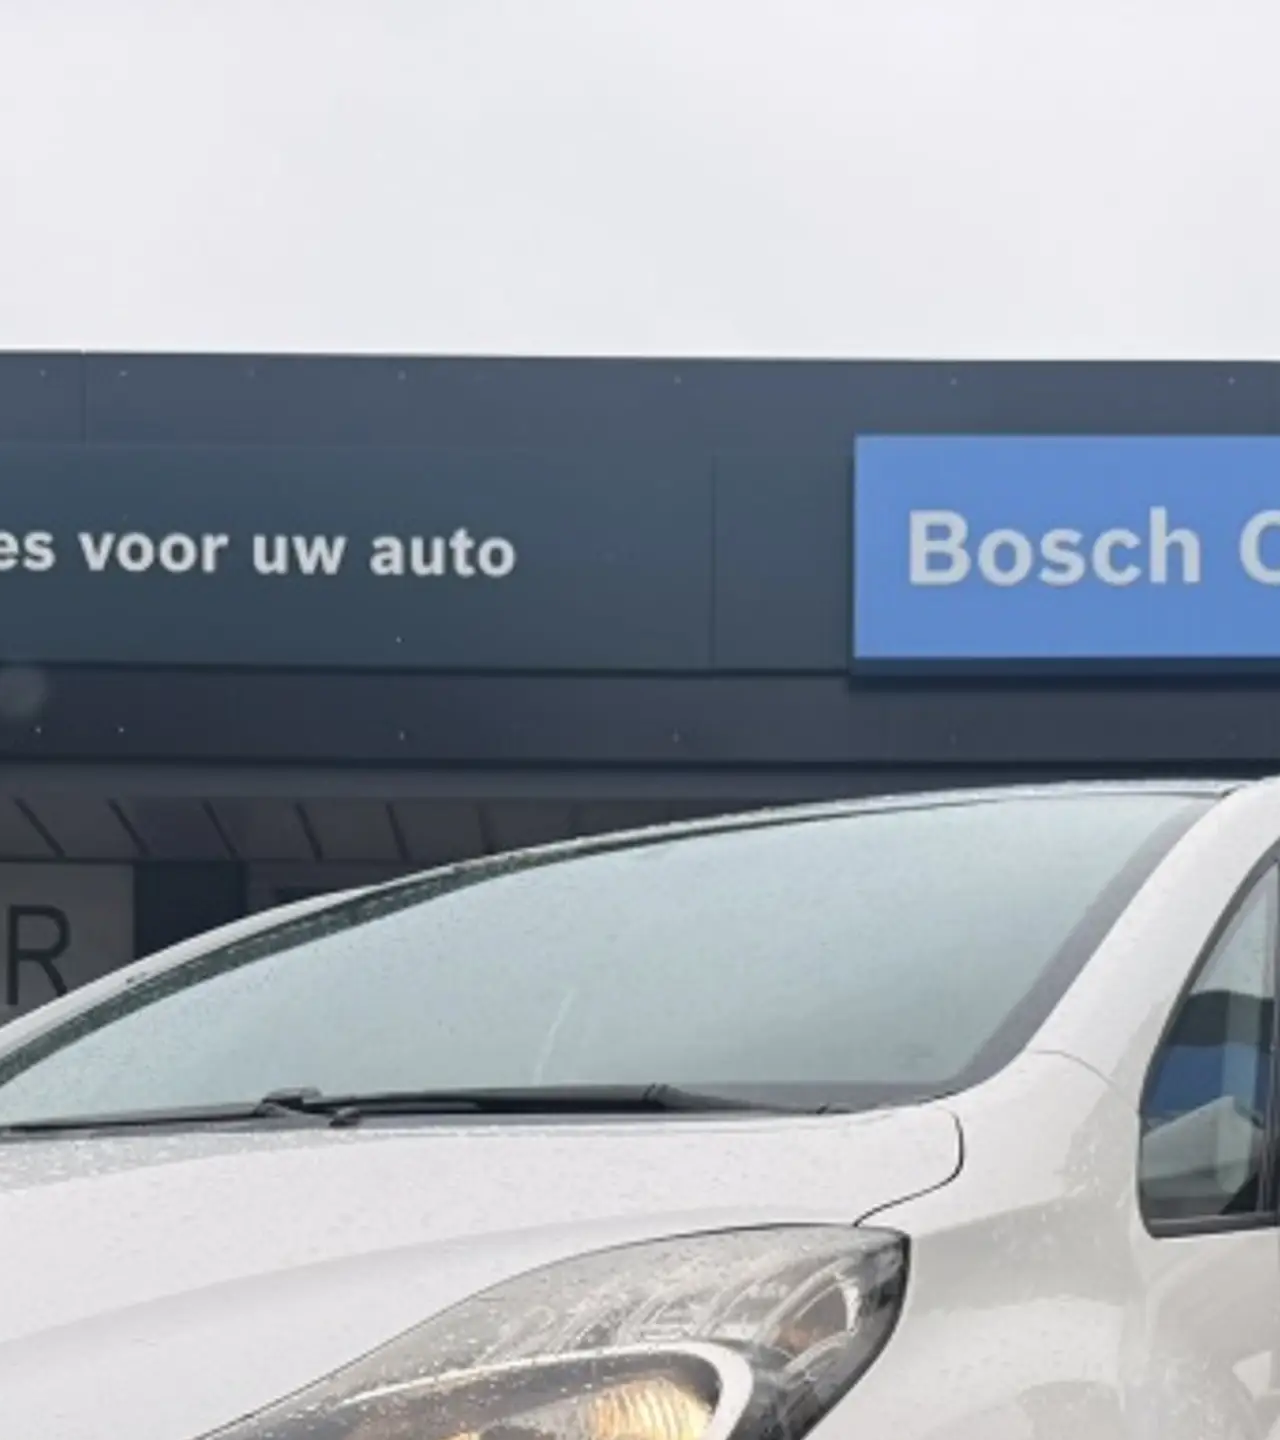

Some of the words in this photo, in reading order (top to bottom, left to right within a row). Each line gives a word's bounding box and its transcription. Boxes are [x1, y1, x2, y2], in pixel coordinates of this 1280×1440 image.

[77, 531, 229, 573] voor
[252, 533, 348, 575] uw
[369, 527, 516, 576] auto
[908, 506, 1202, 588] Bosch
